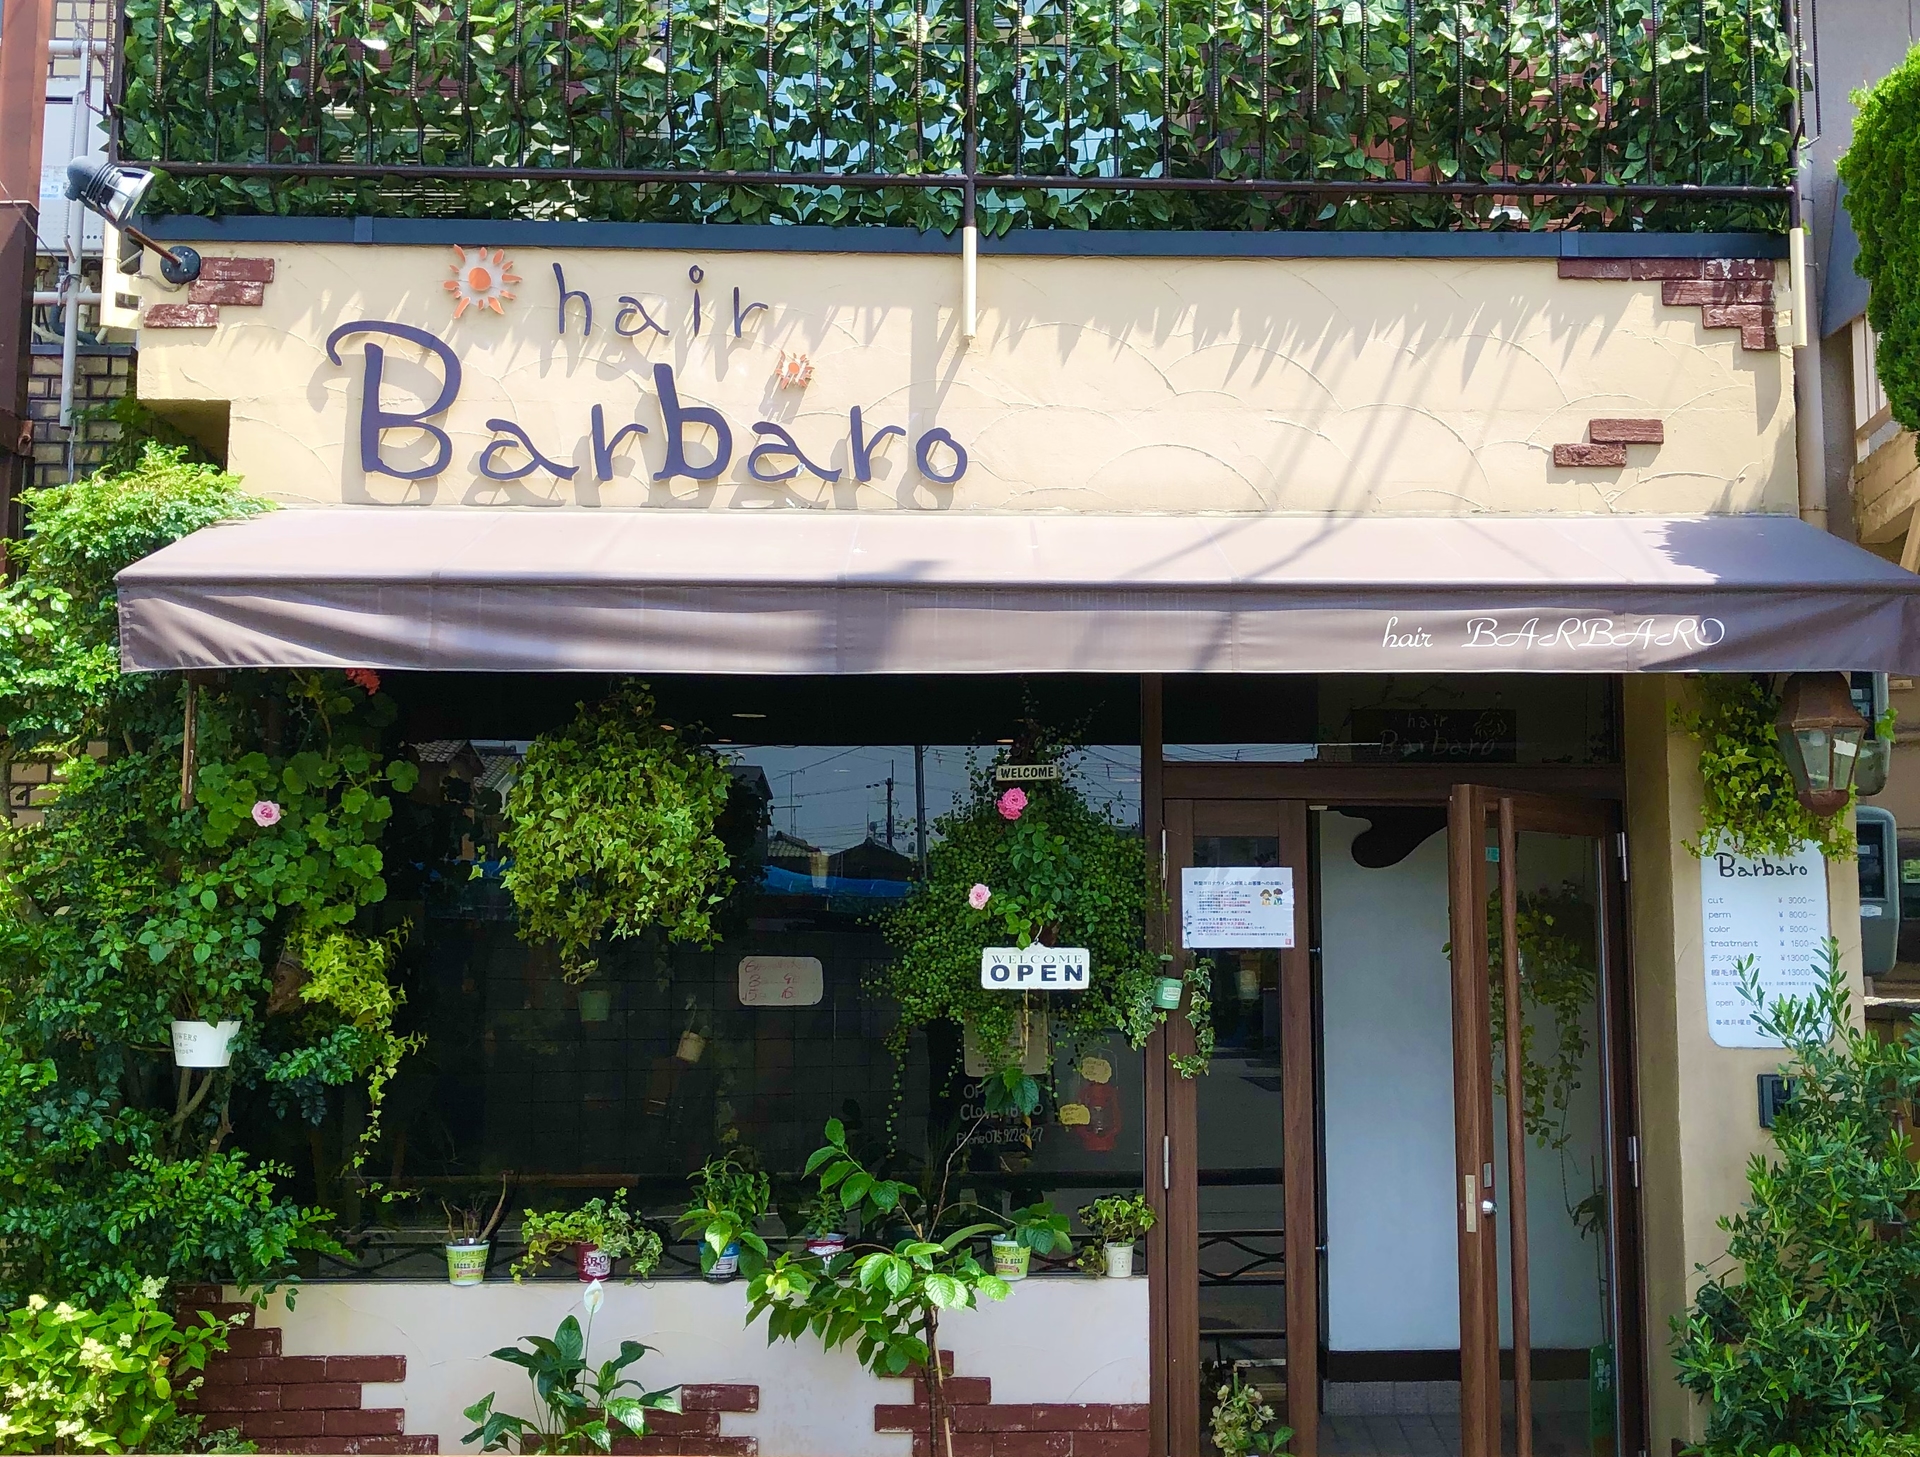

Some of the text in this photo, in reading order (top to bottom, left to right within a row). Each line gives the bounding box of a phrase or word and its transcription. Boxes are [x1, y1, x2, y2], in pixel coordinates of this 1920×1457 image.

[552, 262, 768, 338] hair
[326, 320, 968, 485] Barbaro
[1382, 616, 1726, 651] hair BARBARO
[1407, 713, 1449, 729] hair
[1378, 729, 1496, 756] Barbaro
[1000, 766, 1054, 779] WELCOME
[1713, 852, 1808, 878] Barbaro
[1707, 896, 1724, 905] cut
[1708, 911, 1732, 920] perm
[1709, 925, 1731, 933] color
[1710, 939, 1759, 948] treatment
[992, 954, 1083, 965] WELCOME
[990, 964, 1083, 982] OPEN
[1715, 999, 1733, 1008] open
